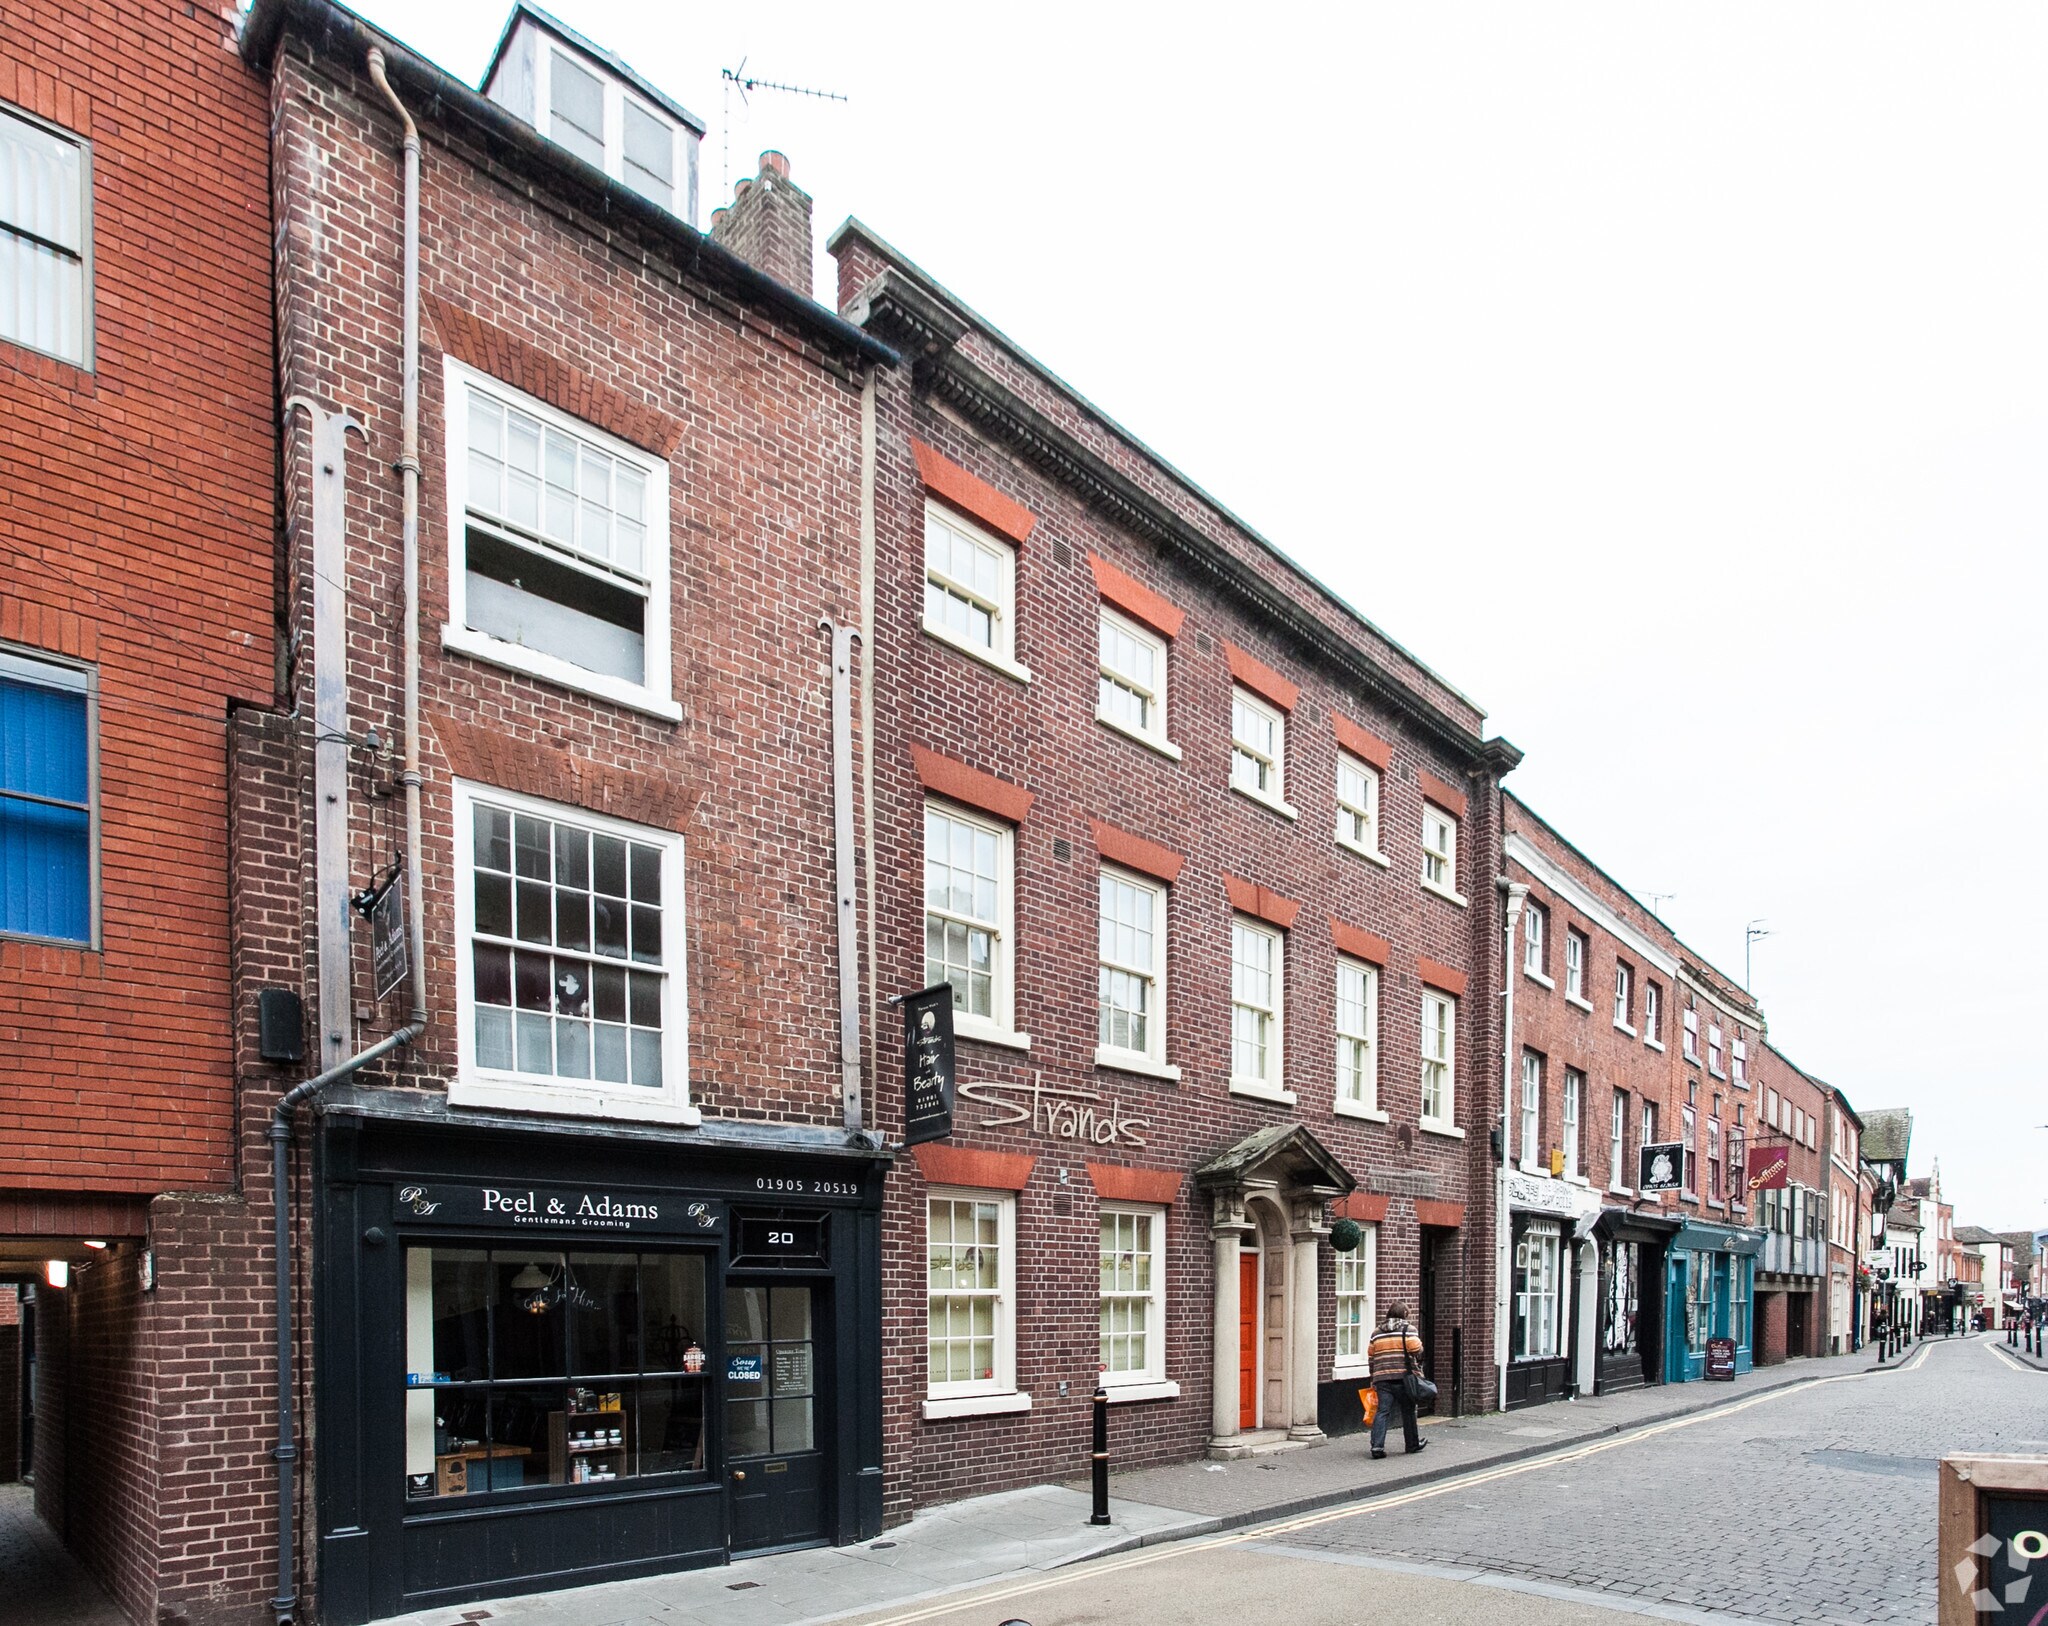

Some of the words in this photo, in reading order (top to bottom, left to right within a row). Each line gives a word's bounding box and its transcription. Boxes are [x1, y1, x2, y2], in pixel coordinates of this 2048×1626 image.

[919, 1050, 940, 1068] Hair
[957, 1070, 1150, 1147] Strands
[1748, 1158, 1786, 1188] Saffrons
[756, 1177, 803, 1191] 01905
[814, 1181, 858, 1194] 20519
[482, 1188, 536, 1213] Peel
[546, 1197, 566, 1215] &
[576, 1195, 659, 1220] Adams
[513, 1214, 576, 1225] Gentlemans
[581, 1218, 631, 1229] Grooming
[768, 1232, 794, 1244] 20
[731, 1356, 757, 1370] Sorry
[728, 1371, 761, 1380] CLOSED
